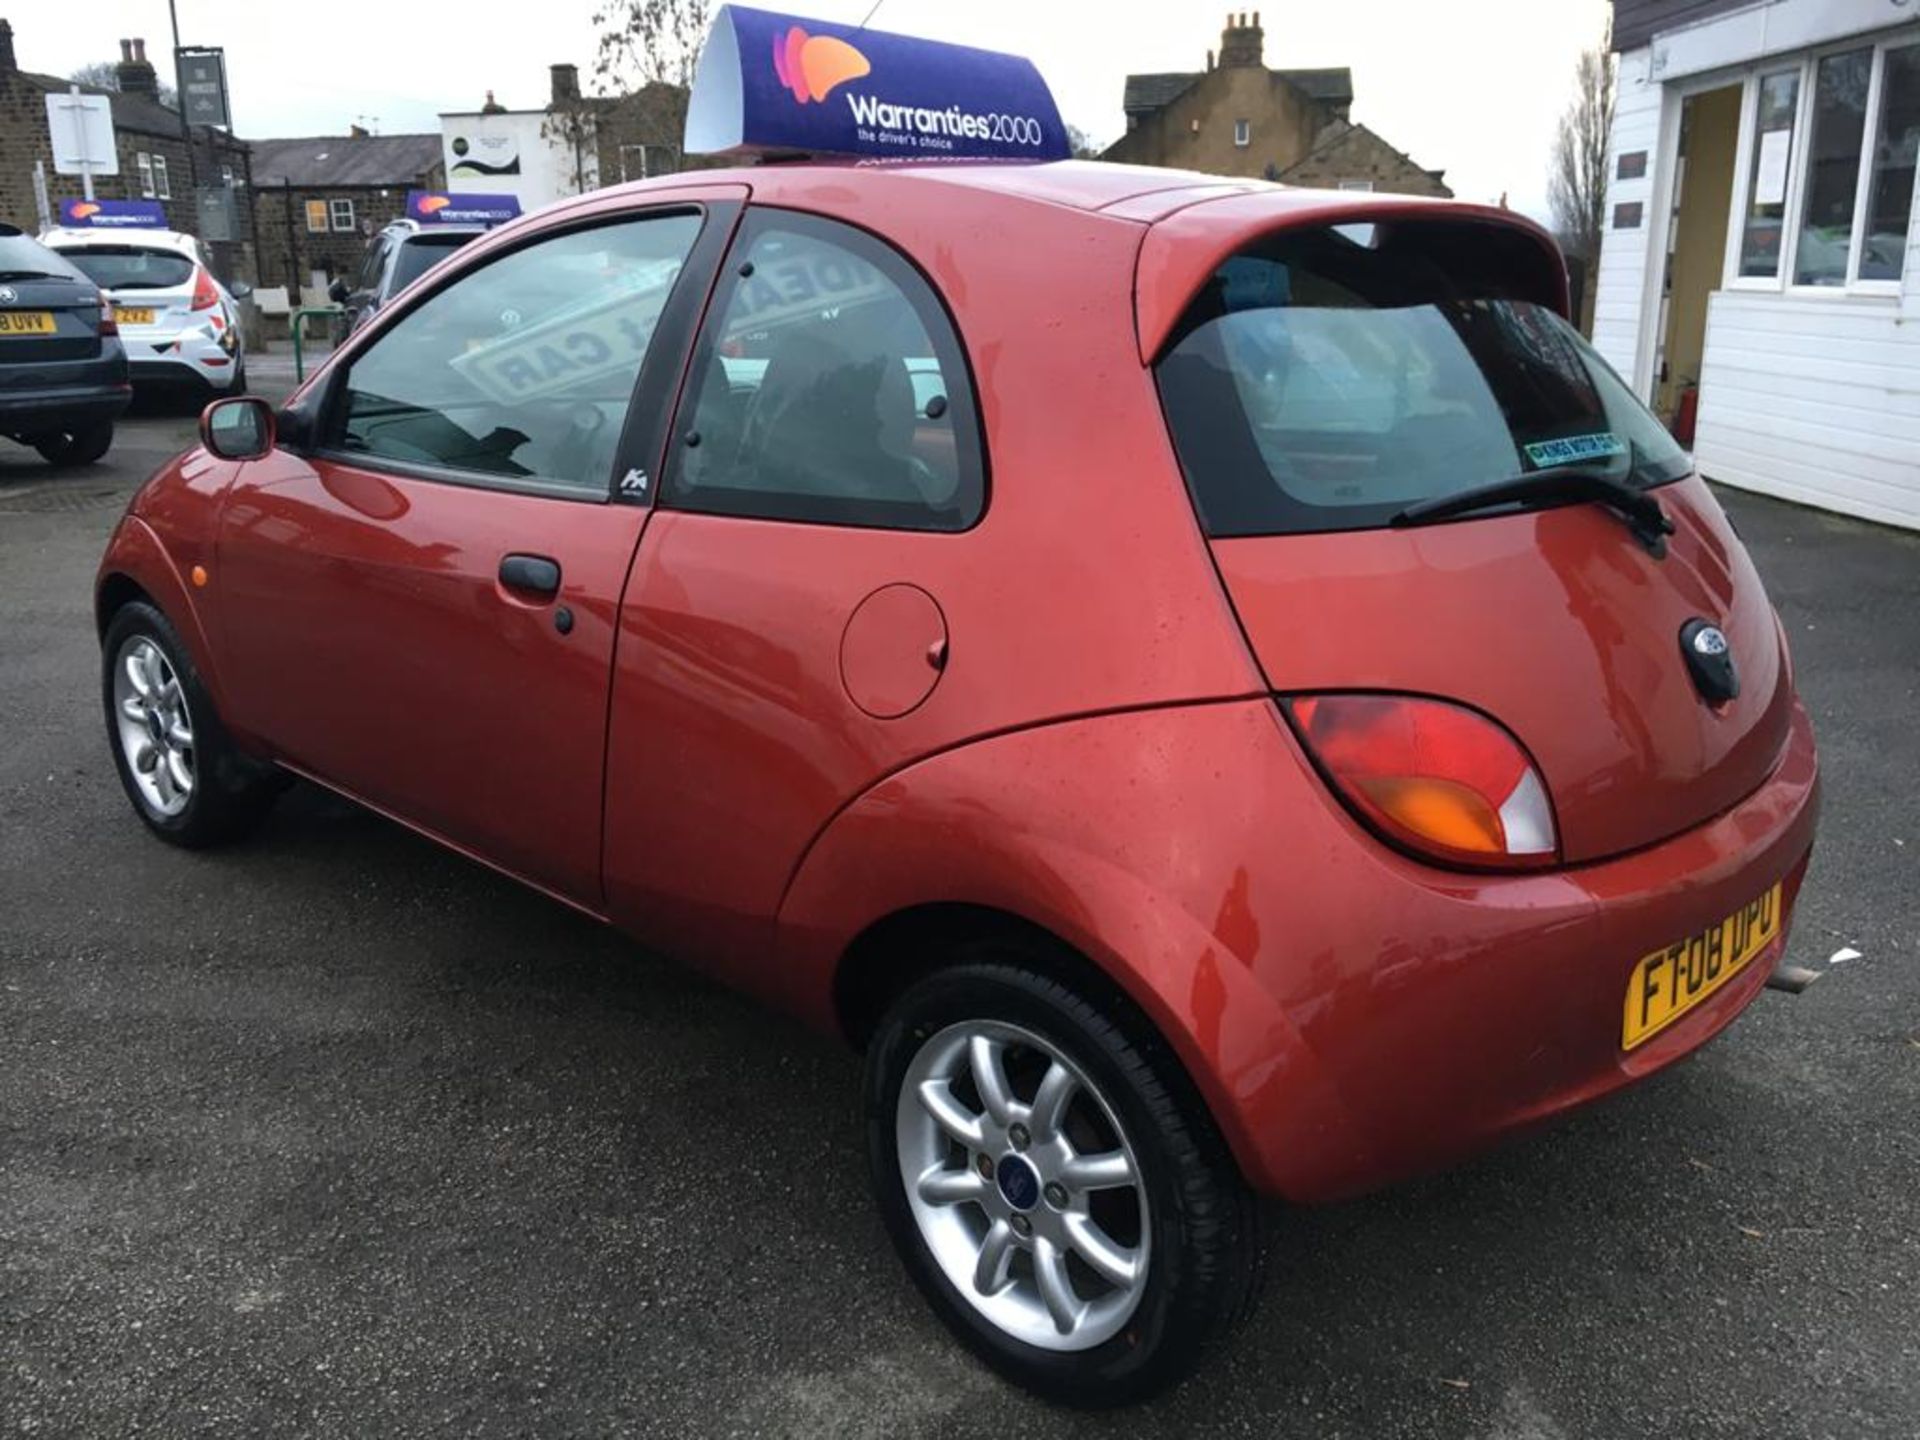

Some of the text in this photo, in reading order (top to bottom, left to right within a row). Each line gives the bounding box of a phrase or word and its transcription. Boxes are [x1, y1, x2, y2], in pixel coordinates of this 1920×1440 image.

[846, 93, 1041, 146] Warranties2000
[858, 129, 952, 149] the driver's choice
